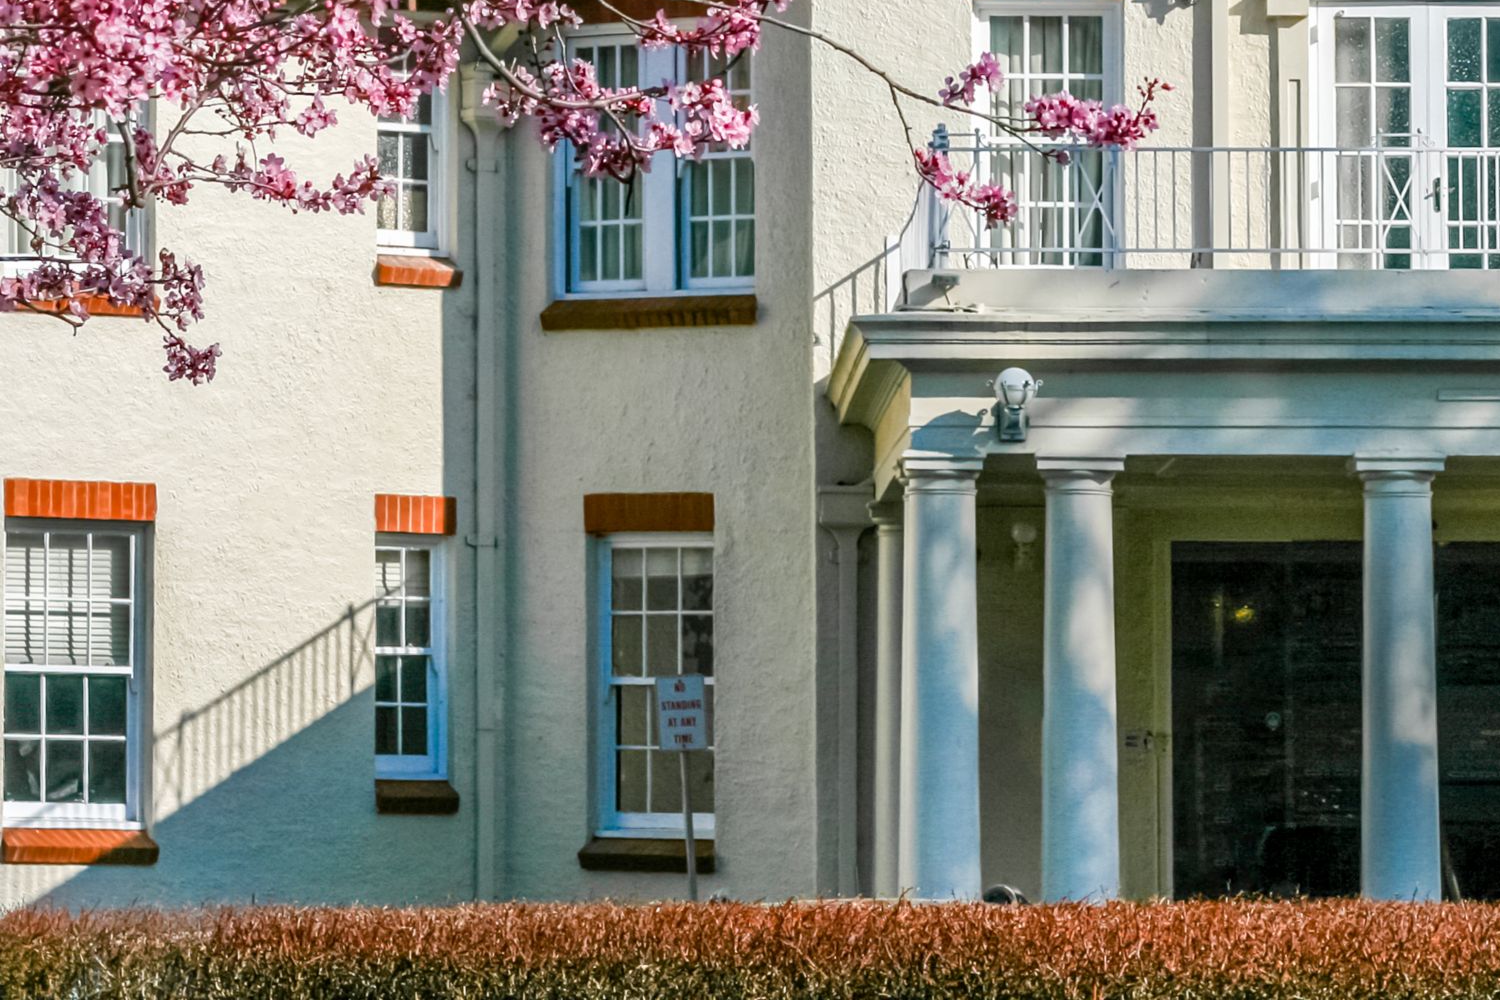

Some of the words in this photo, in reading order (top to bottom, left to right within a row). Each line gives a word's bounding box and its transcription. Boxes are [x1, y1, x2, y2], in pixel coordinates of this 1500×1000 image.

[661, 700, 702, 711] STANDING
[668, 717, 677, 728] AT
[681, 716, 697, 727] ANY
[674, 734, 693, 744] TIME
